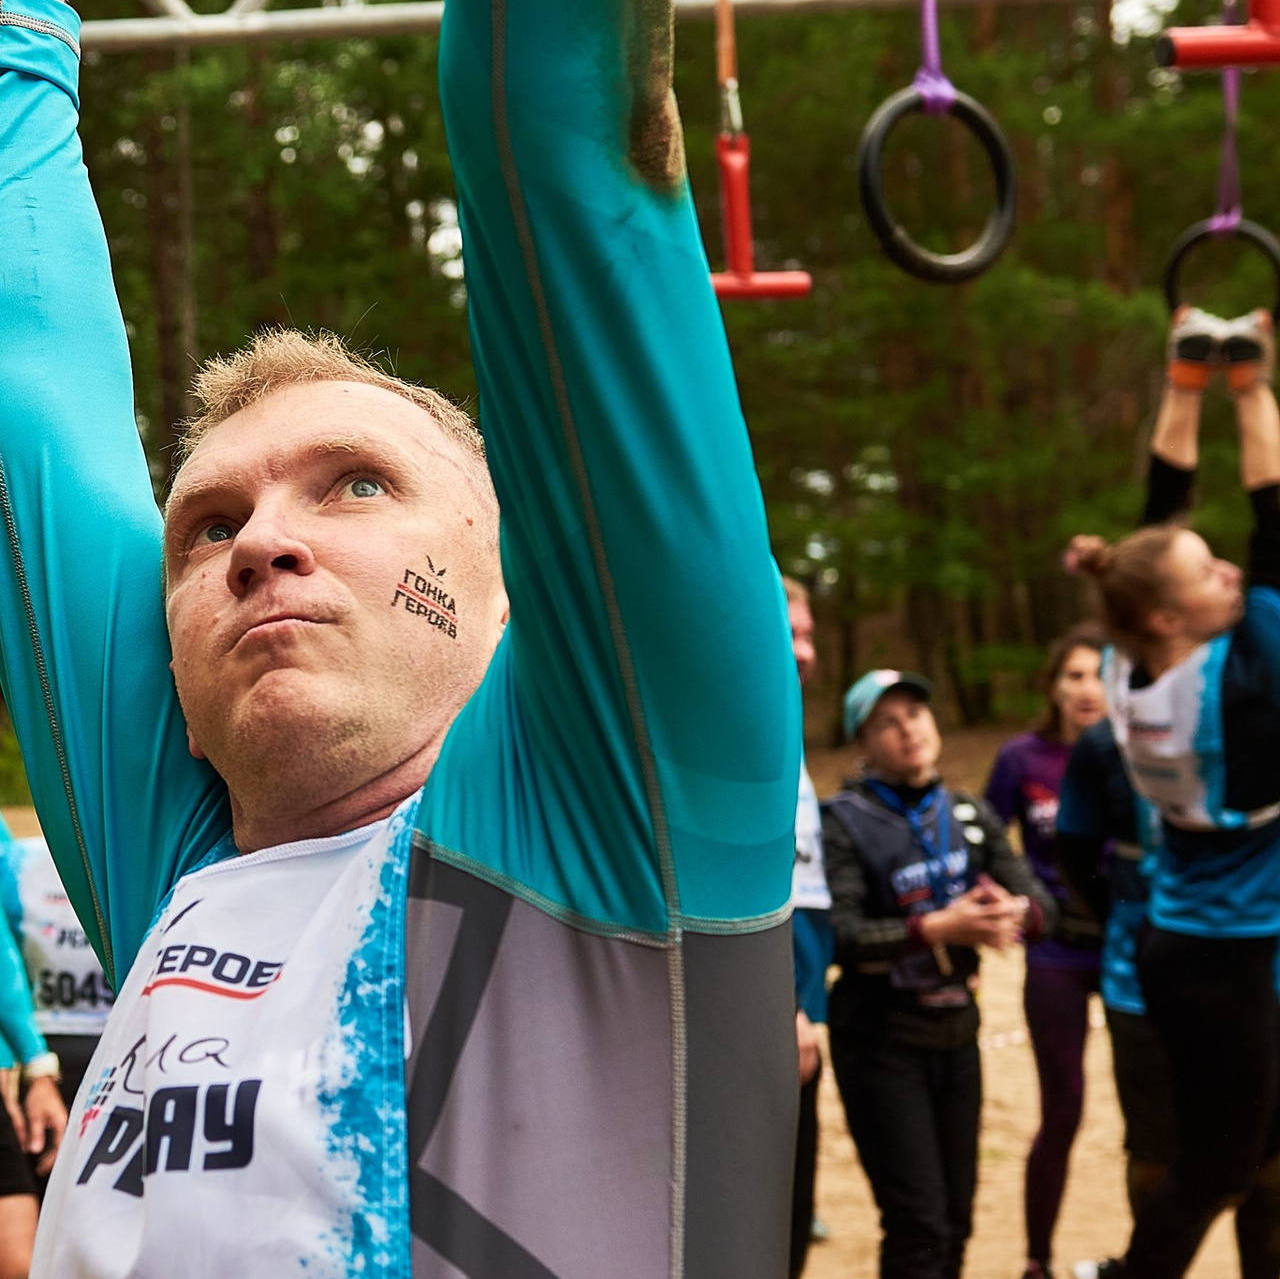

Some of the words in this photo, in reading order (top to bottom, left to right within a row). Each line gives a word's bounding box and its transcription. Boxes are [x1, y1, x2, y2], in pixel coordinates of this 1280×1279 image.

[390, 589, 458, 640] ГЕРОЕВ
[403, 568, 457, 616] ГОНКА
[150, 944, 290, 988] ЕРОЕ
